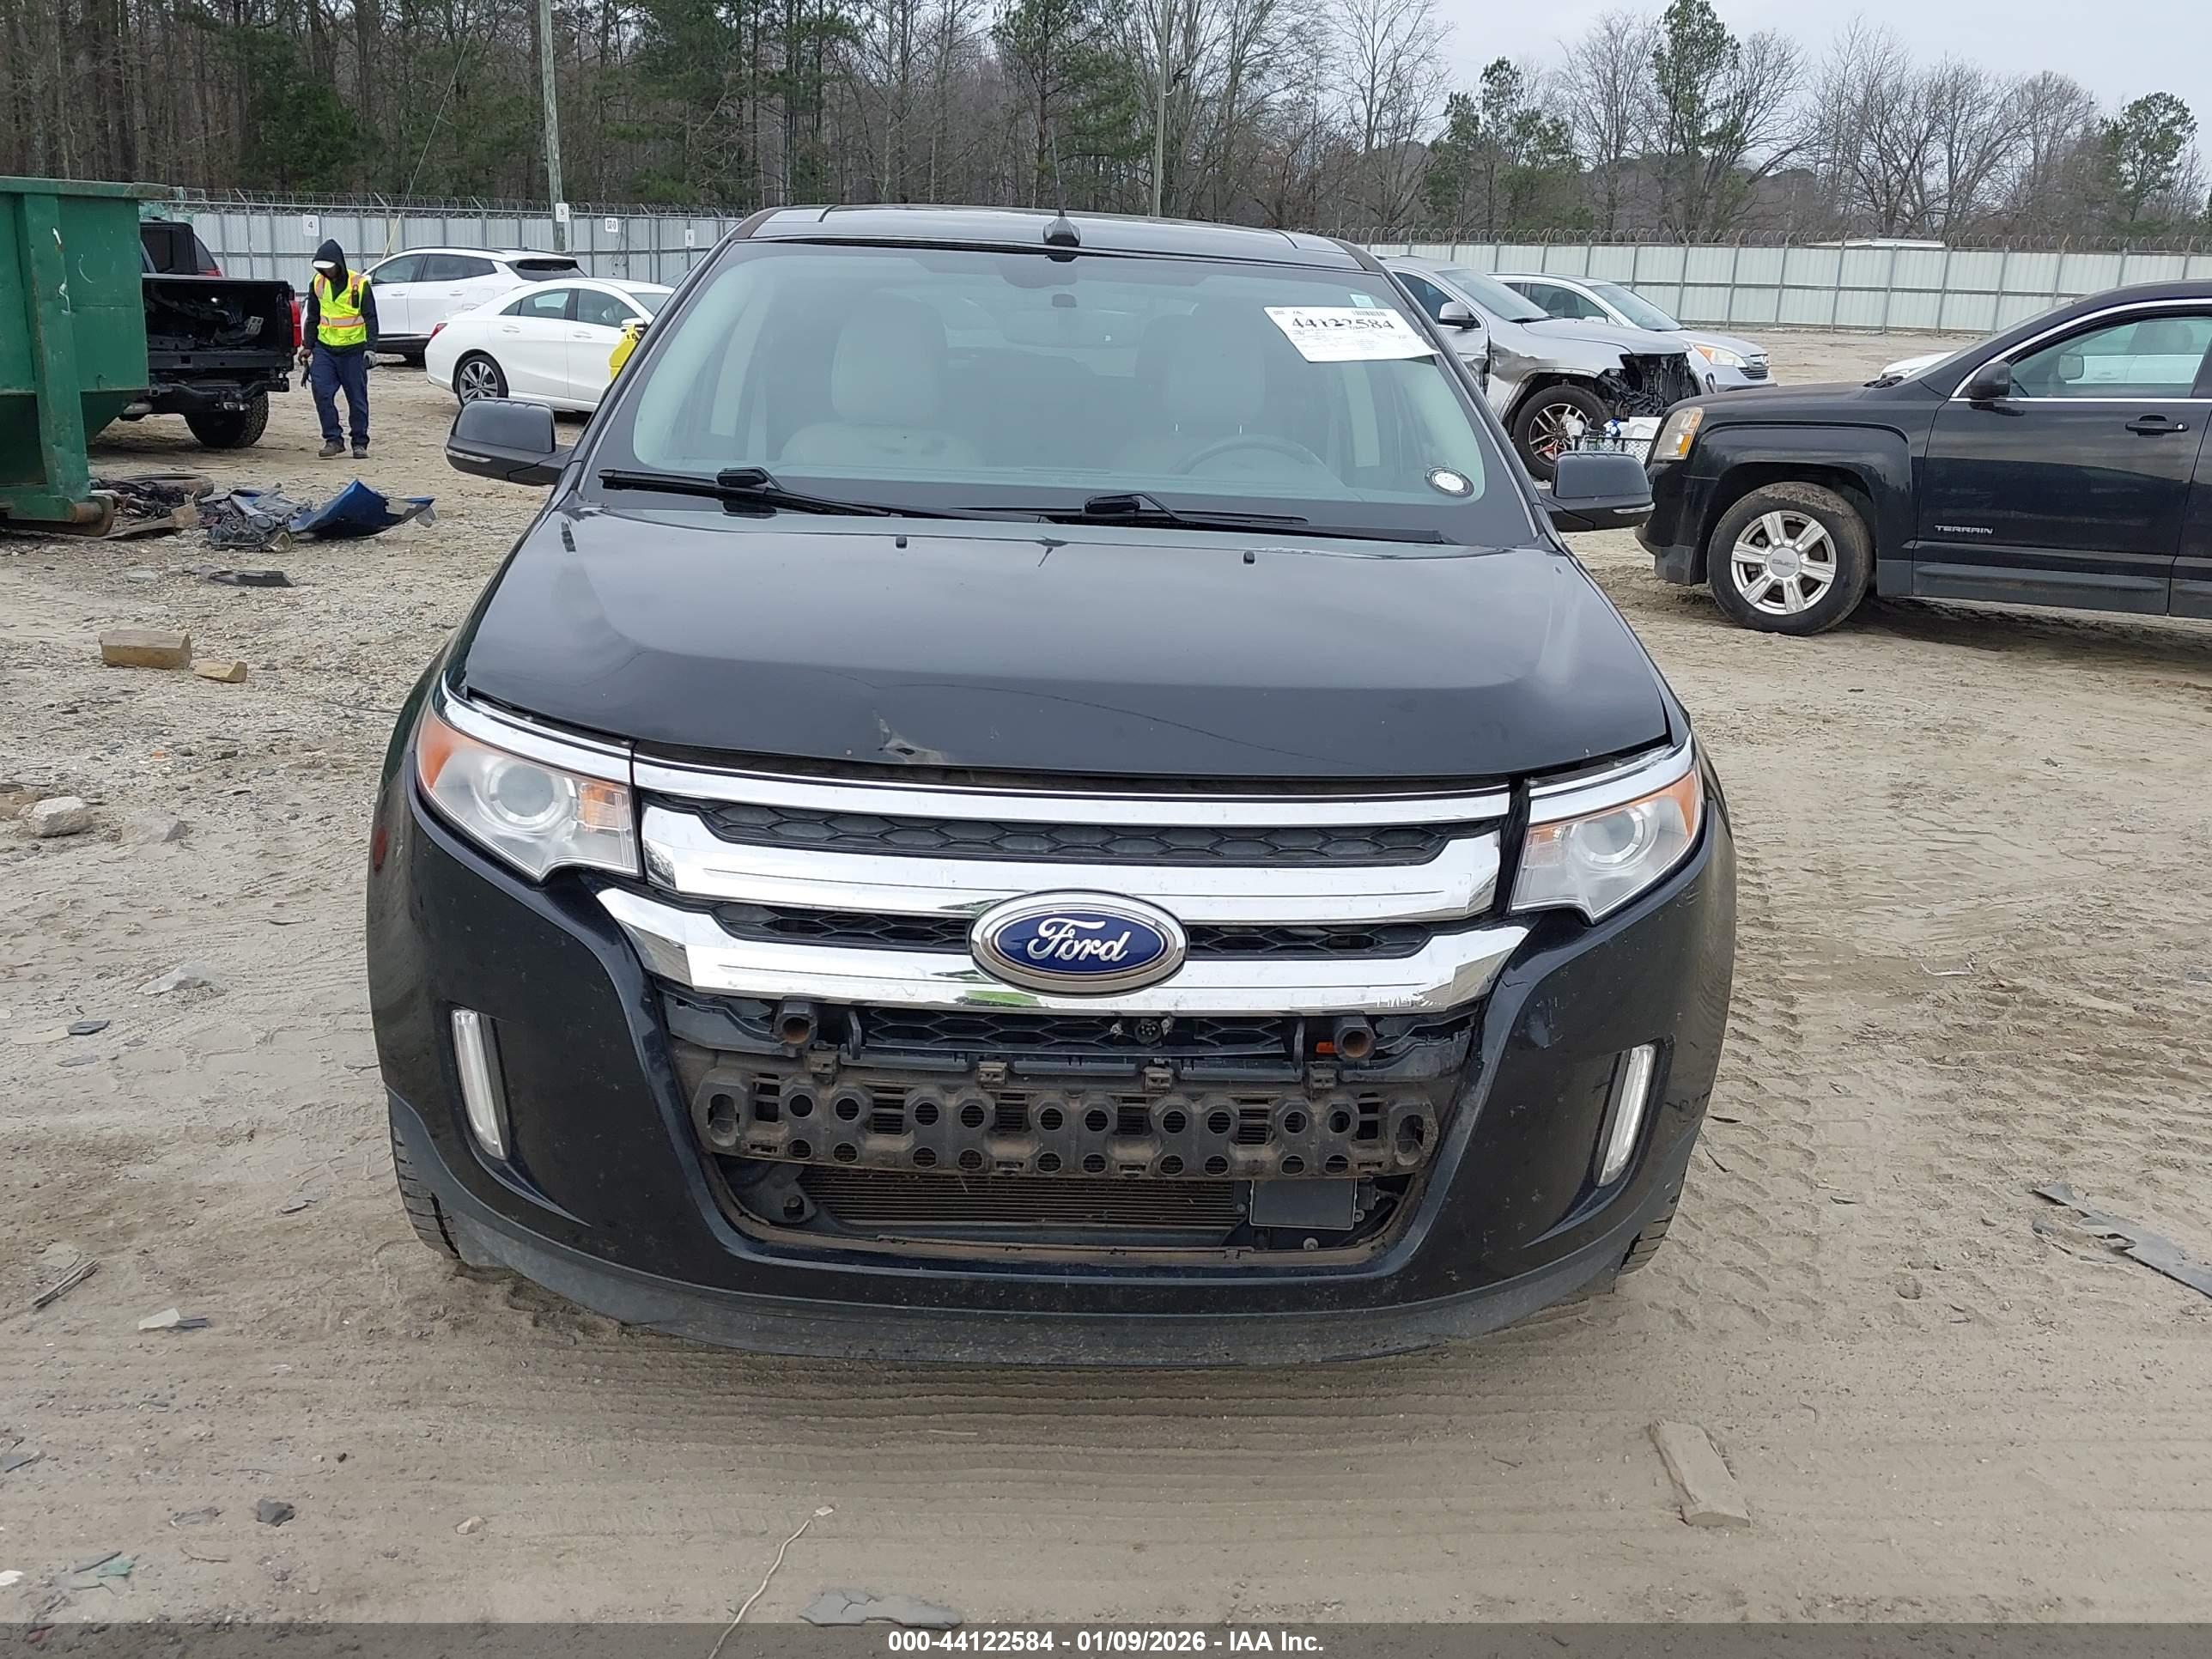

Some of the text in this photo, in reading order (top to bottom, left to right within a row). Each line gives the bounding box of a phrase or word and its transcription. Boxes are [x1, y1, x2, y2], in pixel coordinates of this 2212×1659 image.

[1292, 317, 1395, 330] 44122584
[1935, 525, 1993, 534] TERRAIN
[1772, 558, 1796, 568] GMC
[1027, 917, 1132, 962] Ford
